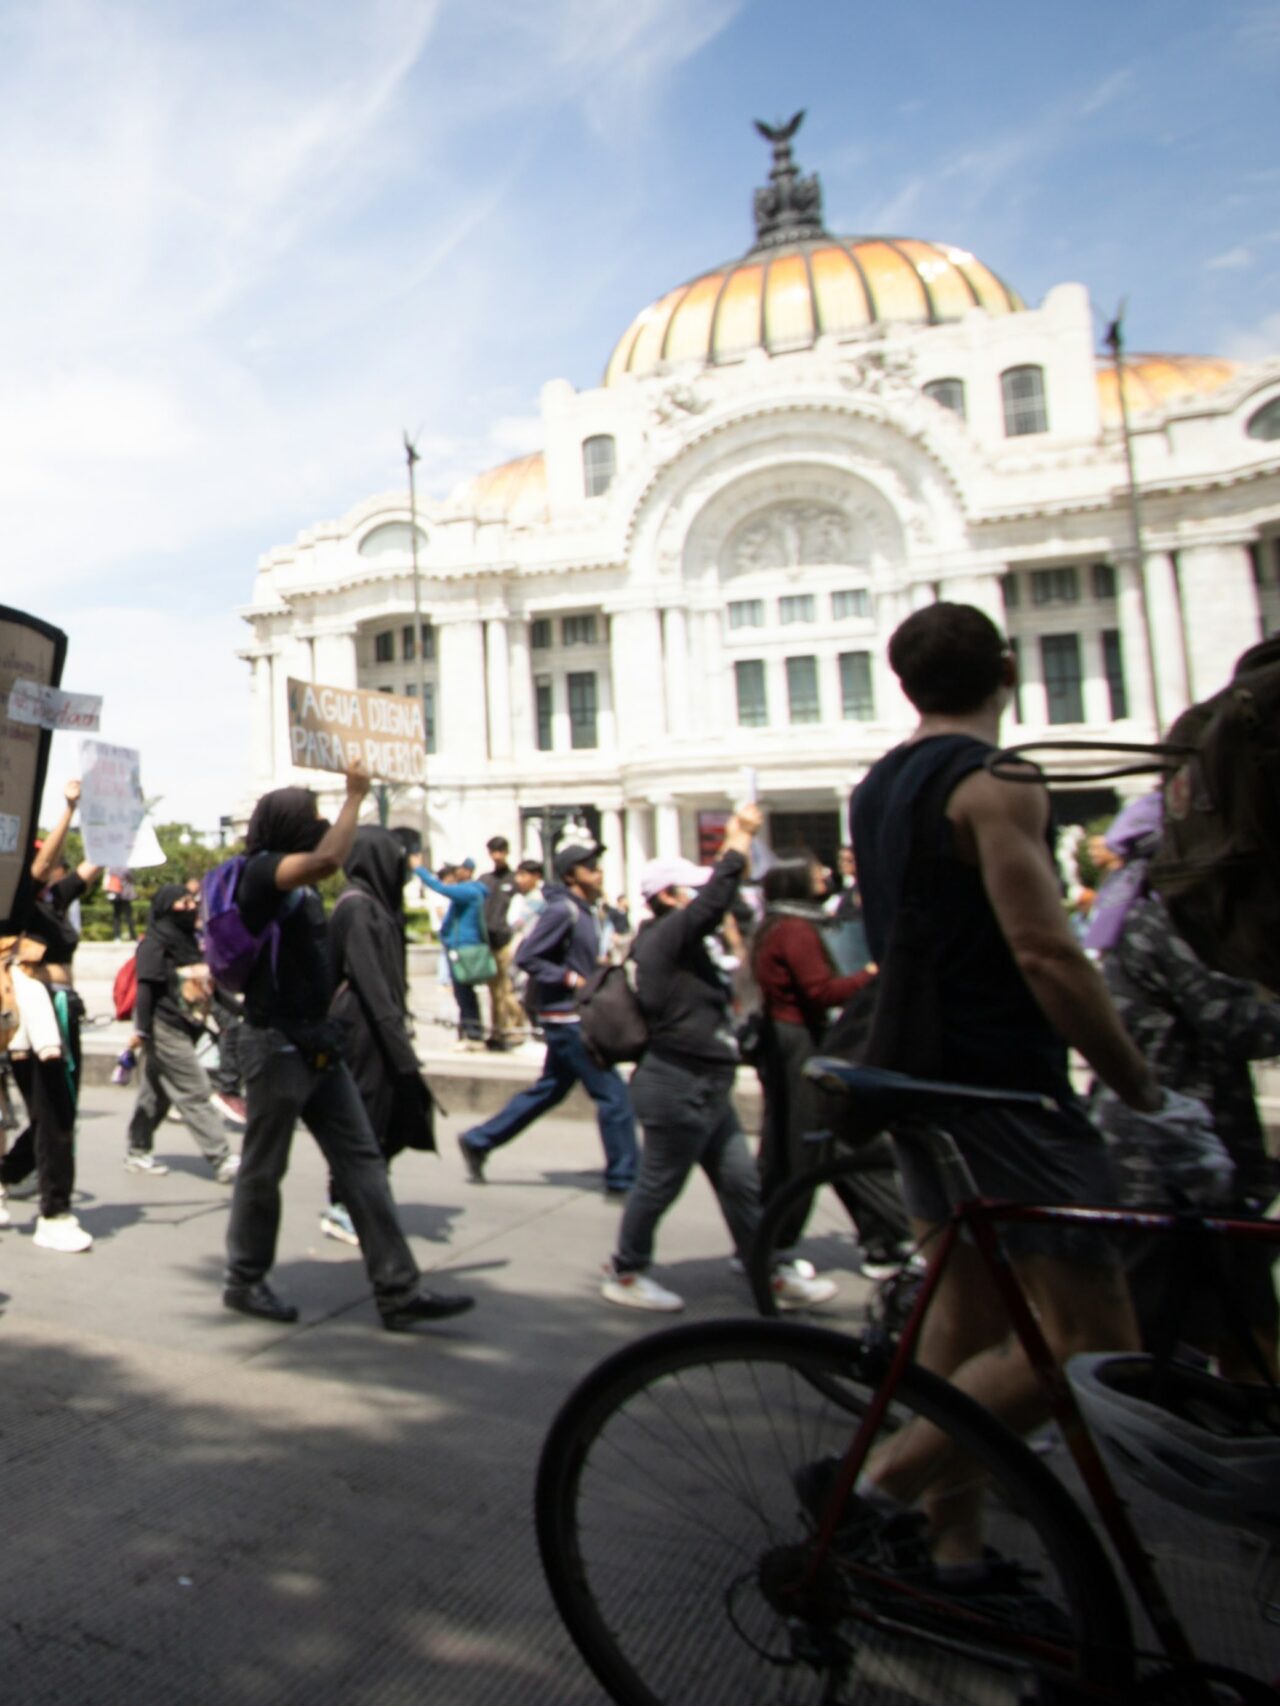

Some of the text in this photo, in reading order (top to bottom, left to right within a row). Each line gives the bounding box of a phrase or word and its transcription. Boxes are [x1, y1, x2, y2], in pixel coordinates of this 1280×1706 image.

[300, 686, 426, 741] AGUA DIGNA
[291, 725, 349, 770] PARA
[365, 738, 425, 780] PUEBLO
